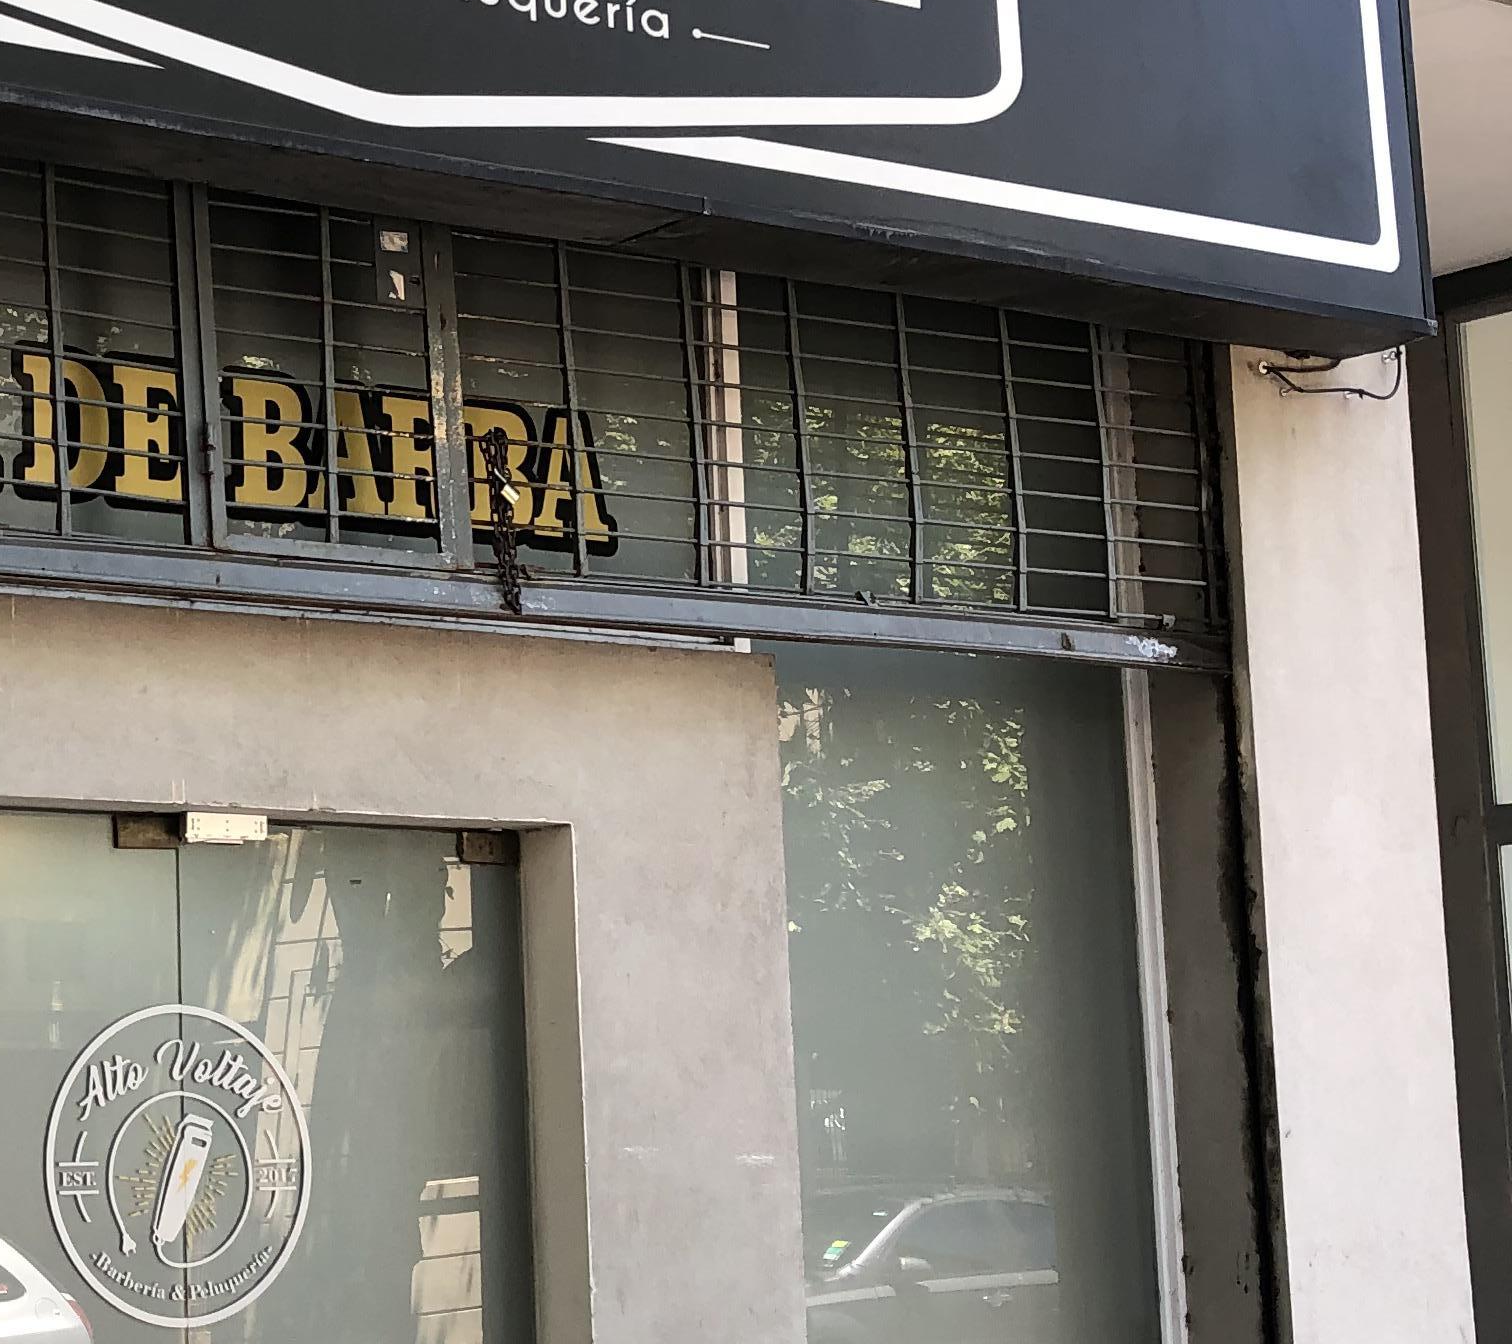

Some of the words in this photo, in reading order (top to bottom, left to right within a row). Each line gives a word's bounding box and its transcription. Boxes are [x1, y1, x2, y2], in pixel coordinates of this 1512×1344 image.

[21, 350, 185, 502] DE
[78, 1054, 149, 1122] Alto
[155, 1038, 283, 1119] Voltaje
[62, 1171, 97, 1187] EST.
[170, 1283, 186, 1302] &
